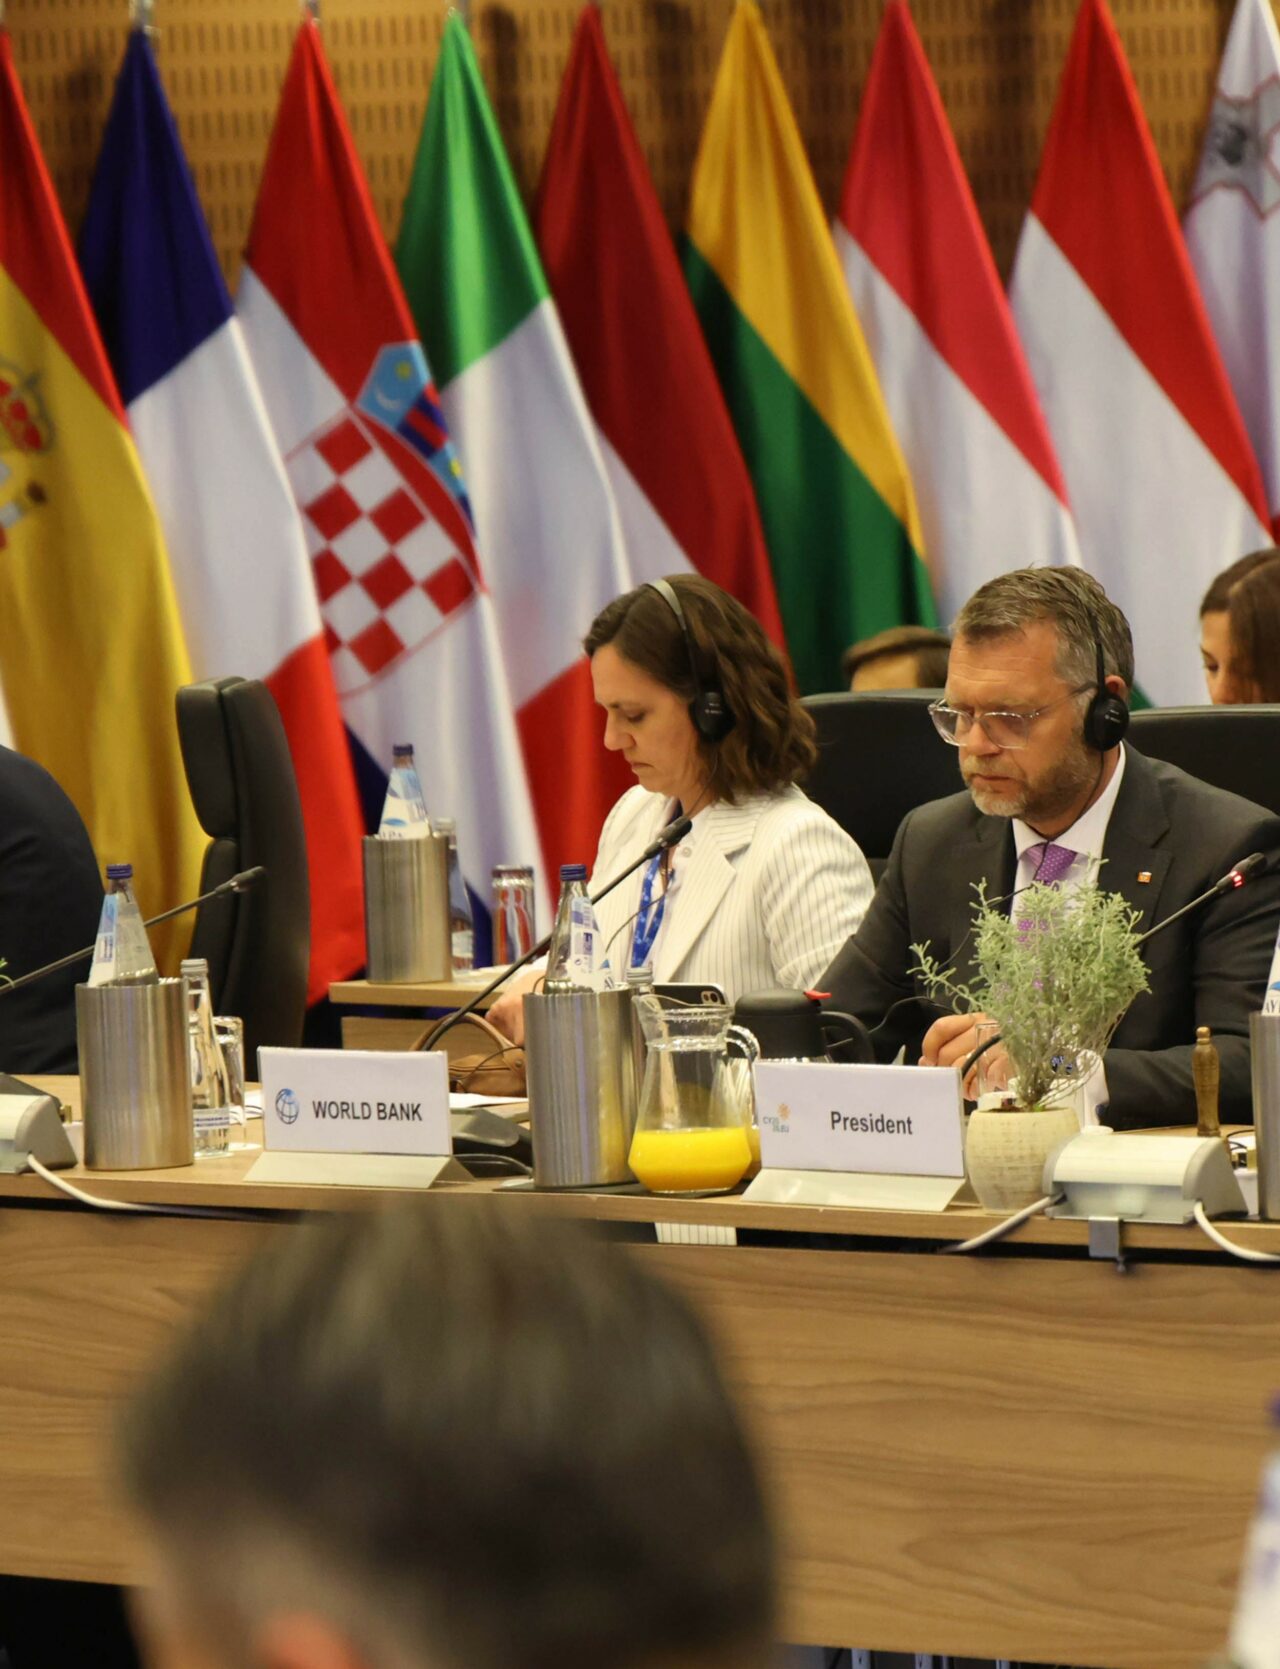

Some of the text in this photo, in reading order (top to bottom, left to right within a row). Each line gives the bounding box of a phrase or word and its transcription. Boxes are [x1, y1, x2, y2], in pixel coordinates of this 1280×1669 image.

[312, 1100, 423, 1122] WORLD BANK
[830, 1110, 913, 1135] President
